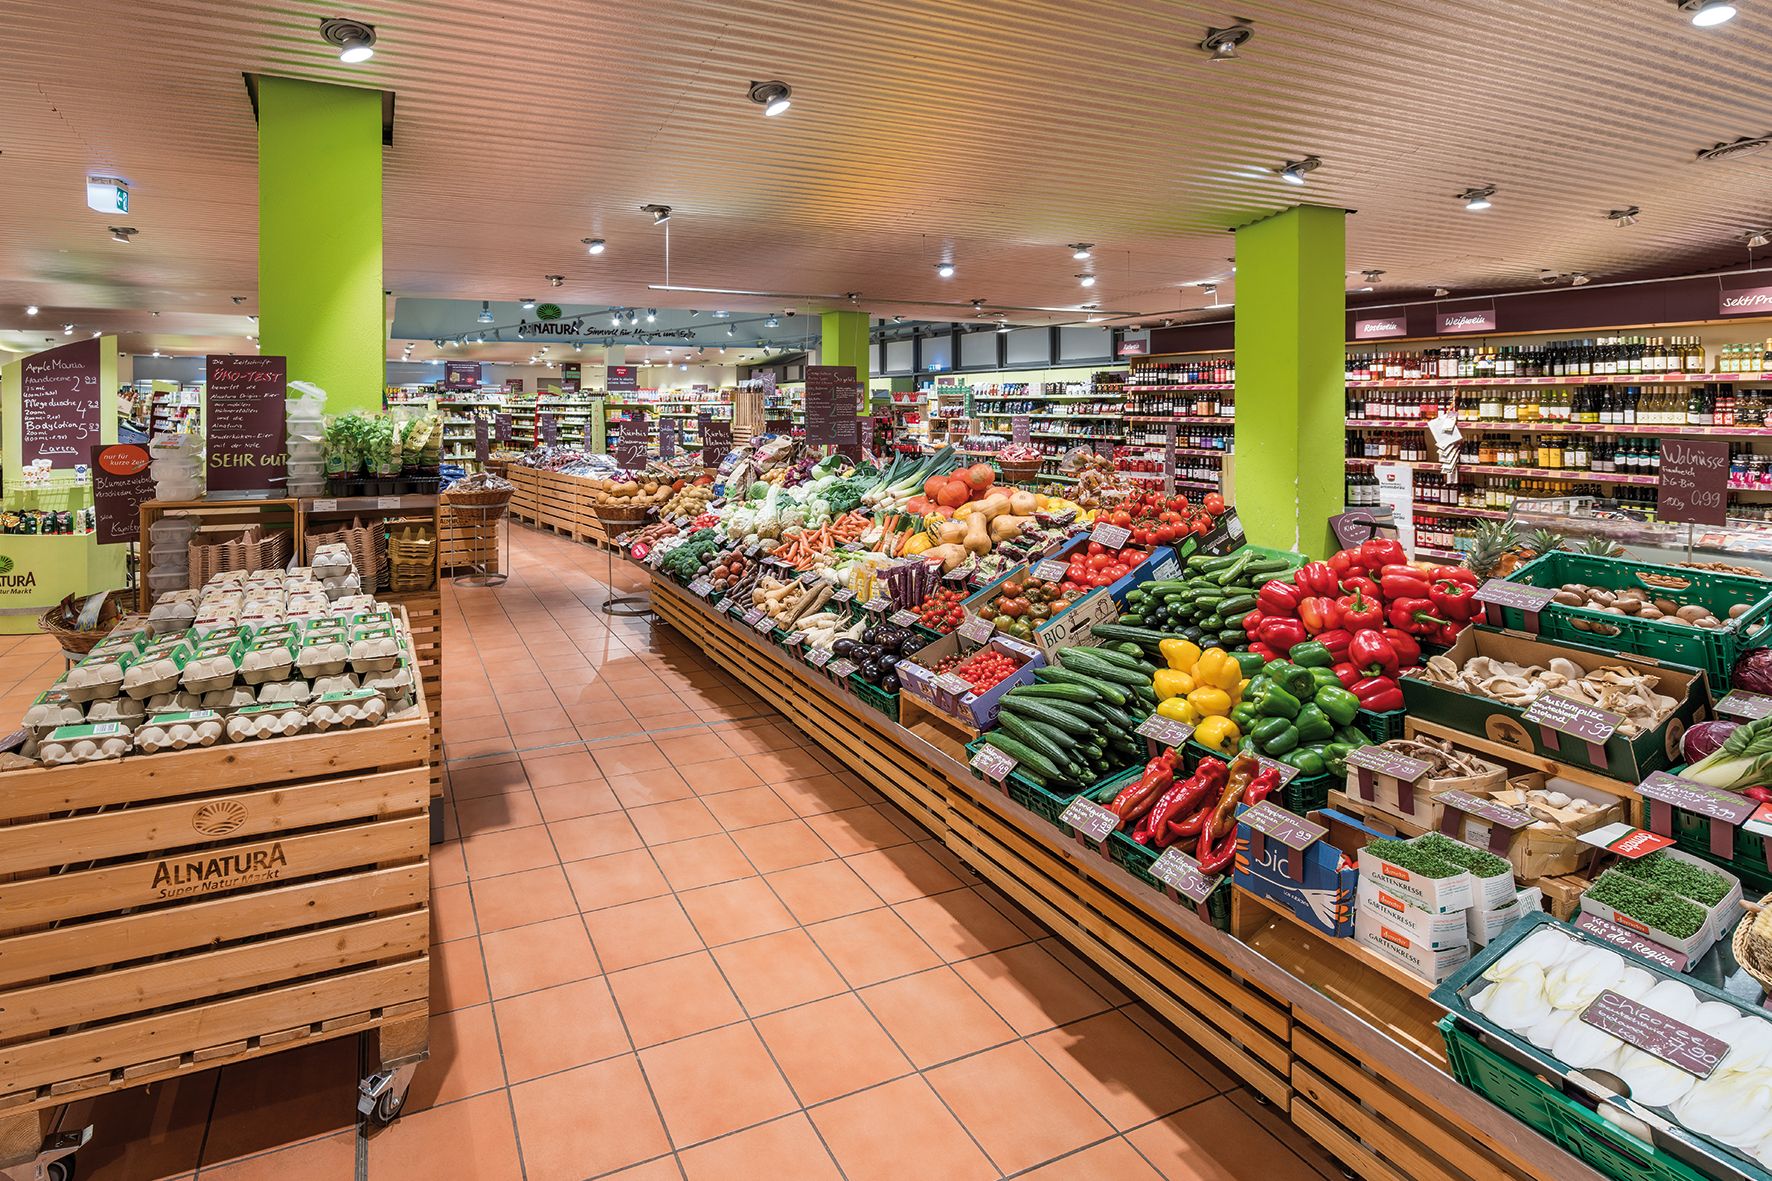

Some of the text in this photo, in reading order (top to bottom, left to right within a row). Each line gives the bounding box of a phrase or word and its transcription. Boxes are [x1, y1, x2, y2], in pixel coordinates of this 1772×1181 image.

[1445, 315, 1485, 328] Weißwein
[26, 359, 84, 373] Apple Mania
[213, 368, 282, 383] ÖKO-TEST
[71, 376, 80, 392] 2
[76, 400, 86, 419] 4
[76, 423, 87, 440] 5
[210, 453, 287, 468] SEHR GUT
[0, 571, 36, 587] TURA
[1043, 624, 1066, 649] BIO
[151, 842, 287, 889] ALNATURA
[159, 869, 280, 899] Super Natur Markt
[1372, 872, 1423, 897] GARTENKRESSE
[1367, 898, 1416, 930] GARTENKRESSE
[1368, 932, 1420, 965] GARTENKRESSE
[1583, 922, 1677, 966] aus der Region
